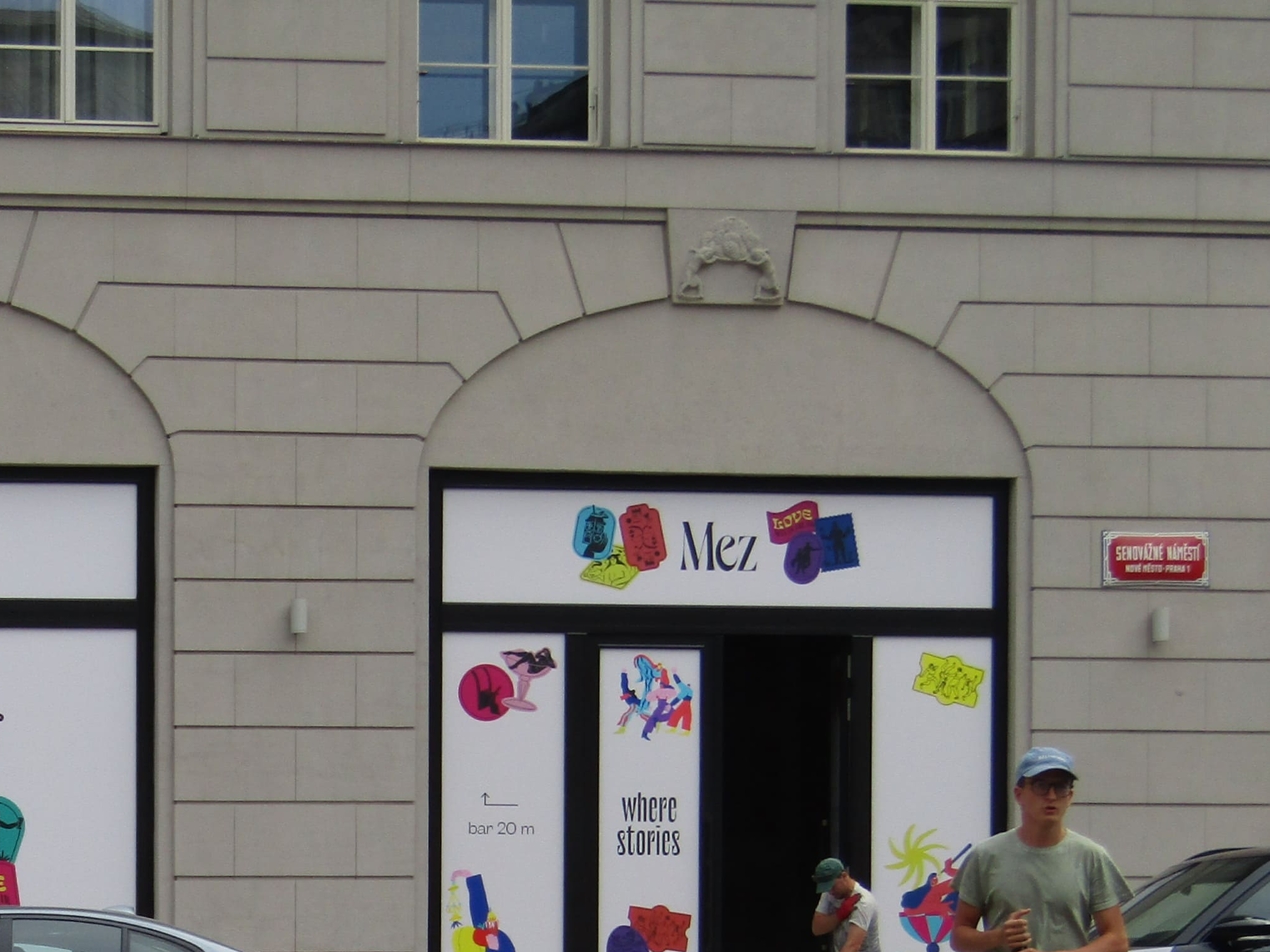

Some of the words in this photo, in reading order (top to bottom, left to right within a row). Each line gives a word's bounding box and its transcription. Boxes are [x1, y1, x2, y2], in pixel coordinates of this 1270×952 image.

[680, 521, 758, 572] Mez
[1116, 543, 1164, 561] SENOVÁŽNÉ
[621, 791, 677, 823] where
[468, 821, 494, 835] bar
[496, 822, 517, 835] 20
[522, 825, 535, 835] m
[616, 826, 681, 856] stories
